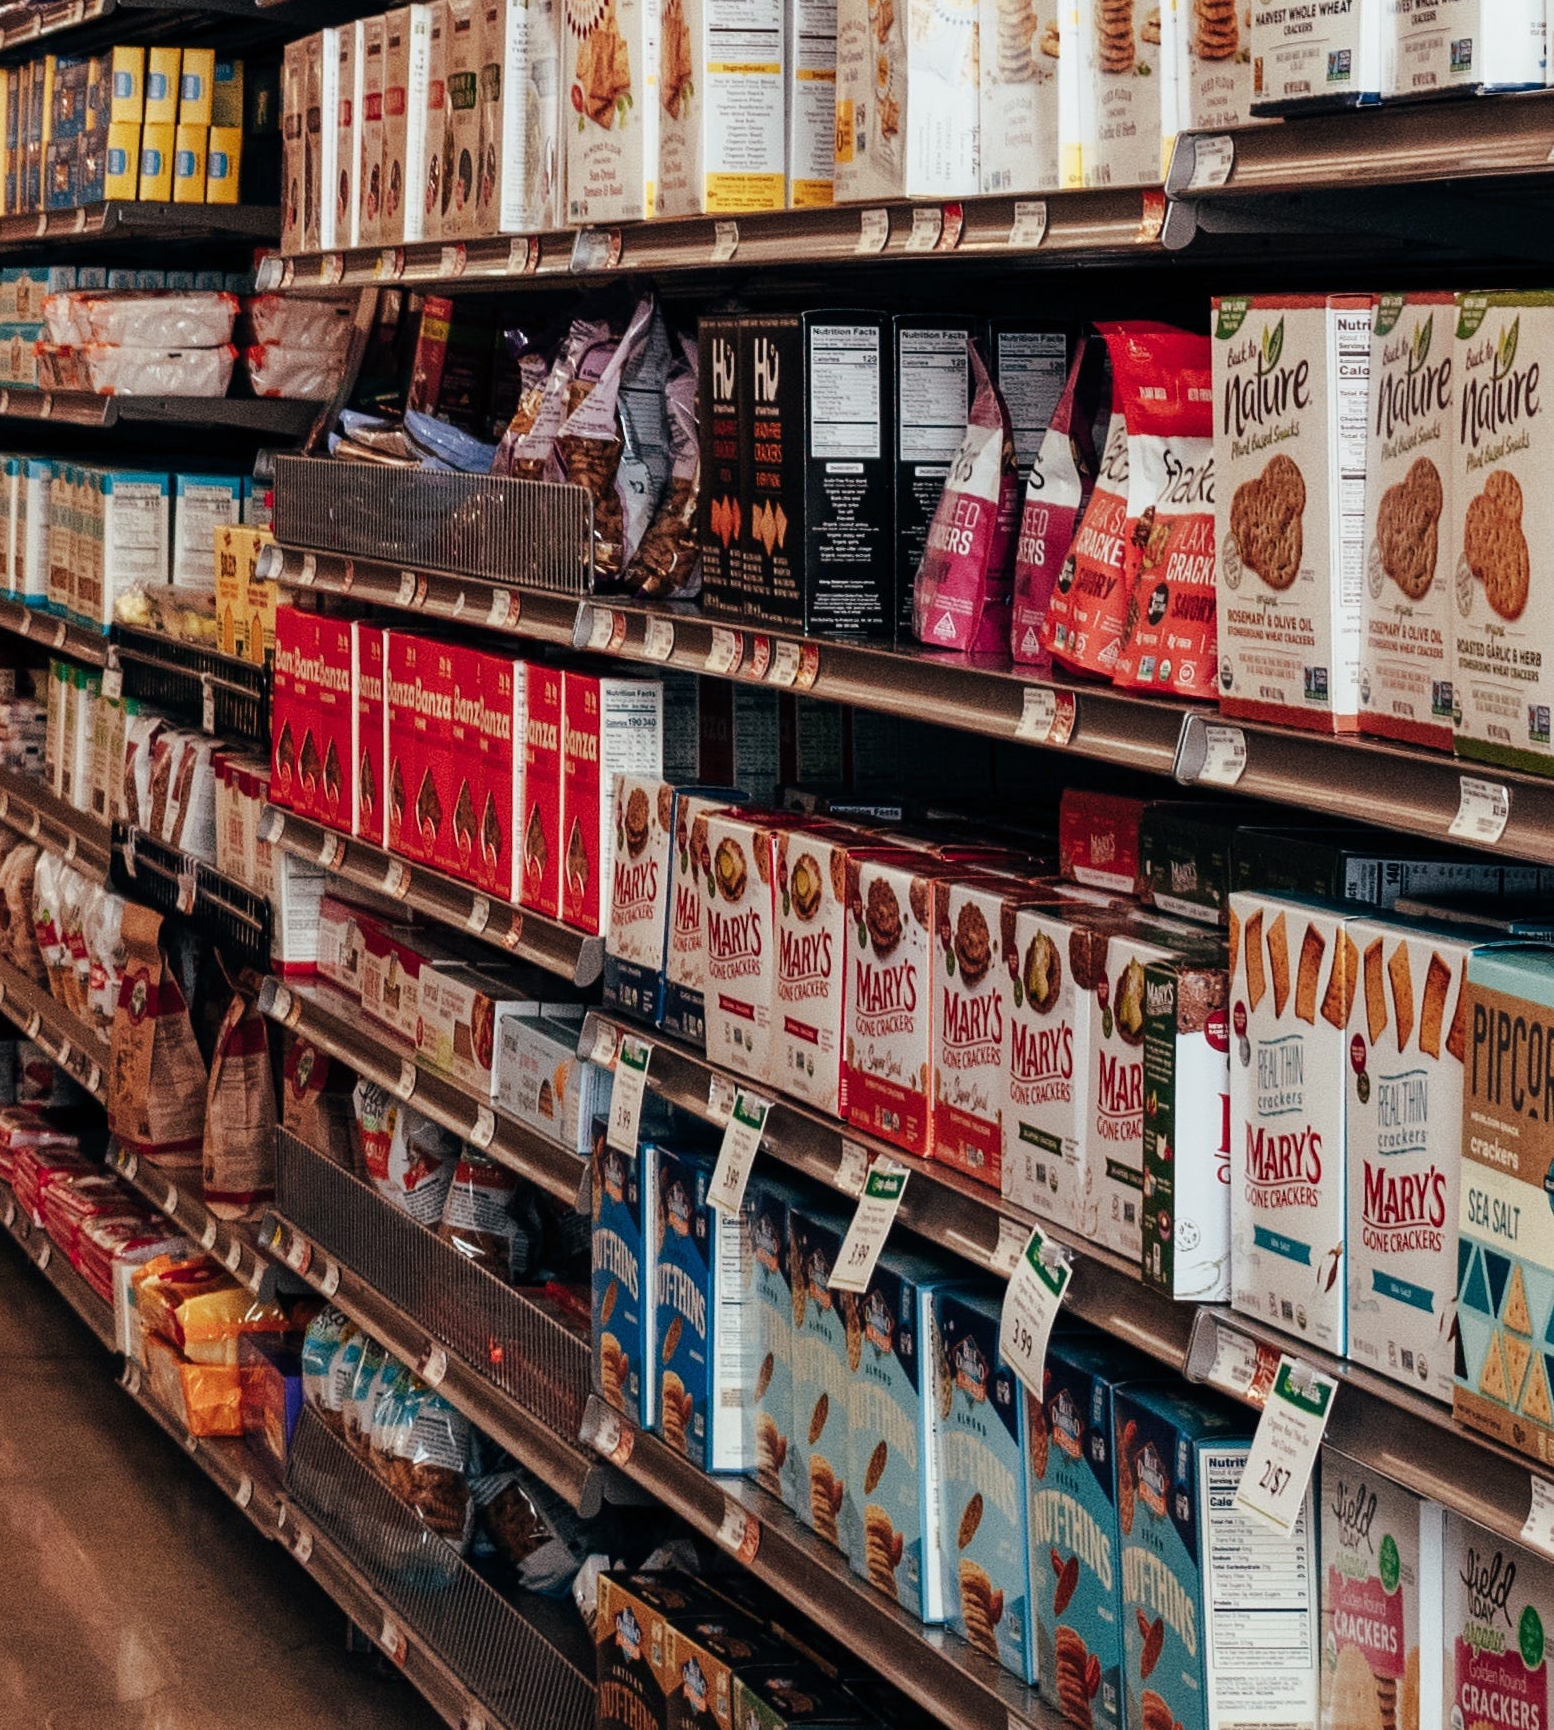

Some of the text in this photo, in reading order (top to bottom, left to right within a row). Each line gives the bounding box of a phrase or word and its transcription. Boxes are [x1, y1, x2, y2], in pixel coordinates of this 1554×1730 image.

[1255, 0, 1353, 26] HARVEST WHOLE WHEAT
[1283, 22, 1313, 36] CRACKERS
[1223, 358, 1312, 439] nature
[1376, 356, 1453, 441] nature
[1460, 361, 1540, 448] nature
[1228, 608, 1314, 633] ROSEMARY OLIVE OIL
[1521, 650, 1543, 667] HERB
[614, 859, 658, 904] MARY'S
[707, 906, 762, 959] MARY'S
[779, 926, 832, 979] MARY'S
[856, 958, 917, 1015] MARY'S
[856, 1014, 914, 1035] GONE CRACKERS
[943, 986, 1003, 1046] MARY'S
[1010, 1019, 1074, 1086] MARY'S
[1010, 1082, 1071, 1103] GONE CRACKERS
[617, 1106, 631, 1129] 3.99
[1245, 1123, 1322, 1184] MARY'S
[1470, 1134, 1519, 1170] crackers
[1245, 1184, 1319, 1209] GONE CRACKERS
[1363, 1160, 1447, 1228] MARY'S
[1468, 1187, 1521, 1243] SEA SALT
[847, 1244, 870, 1268] 3.99
[1363, 1224, 1442, 1253] GONE CRACKERS
[1010, 1327, 1034, 1360] 3.99
[1258, 1454, 1292, 1499] 2/$7
[1459, 1548, 1516, 1627] field
[1333, 1609, 1399, 1655] CRACKERS
[1473, 1600, 1497, 1624] DAY
